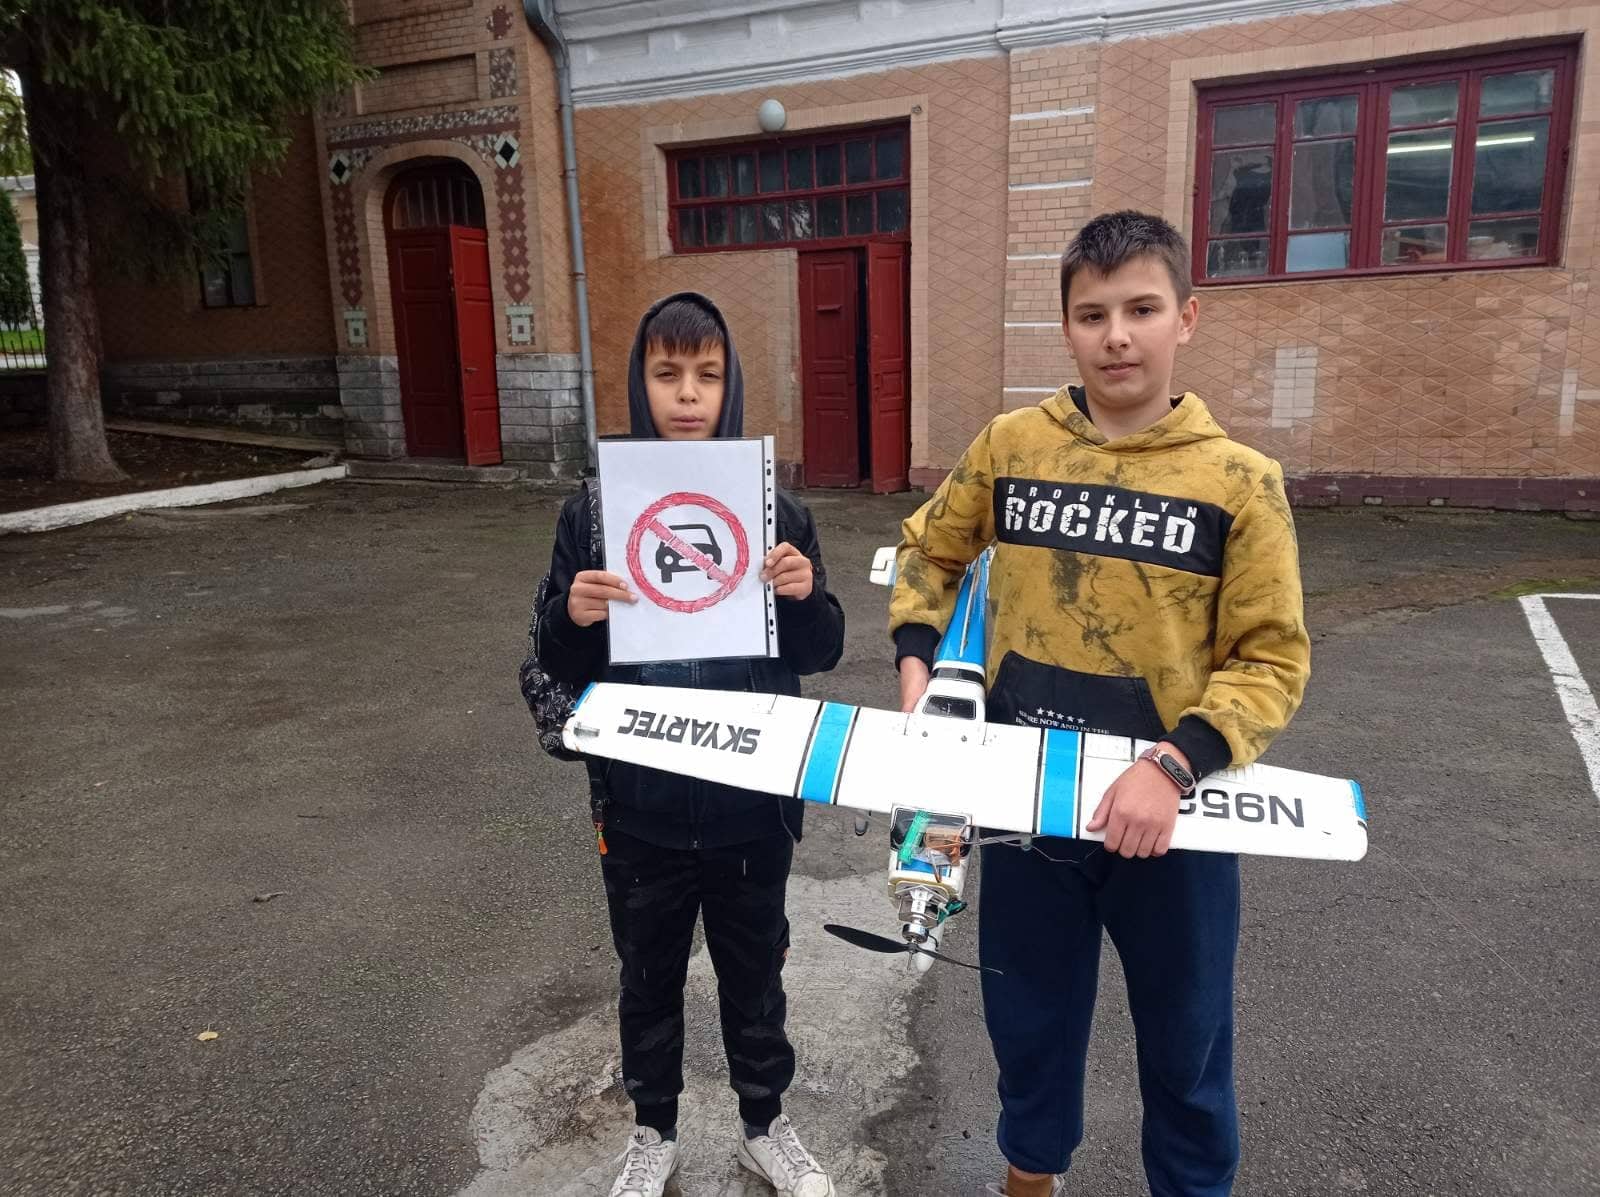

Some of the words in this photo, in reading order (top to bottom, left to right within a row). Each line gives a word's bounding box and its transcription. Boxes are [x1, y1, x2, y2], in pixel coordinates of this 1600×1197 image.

[1007, 484, 1198, 518] BROOKLYN
[1005, 496, 1196, 554] ROCKED
[617, 708, 760, 755] SKYARTEC
[1060, 722, 1079, 731] AND
